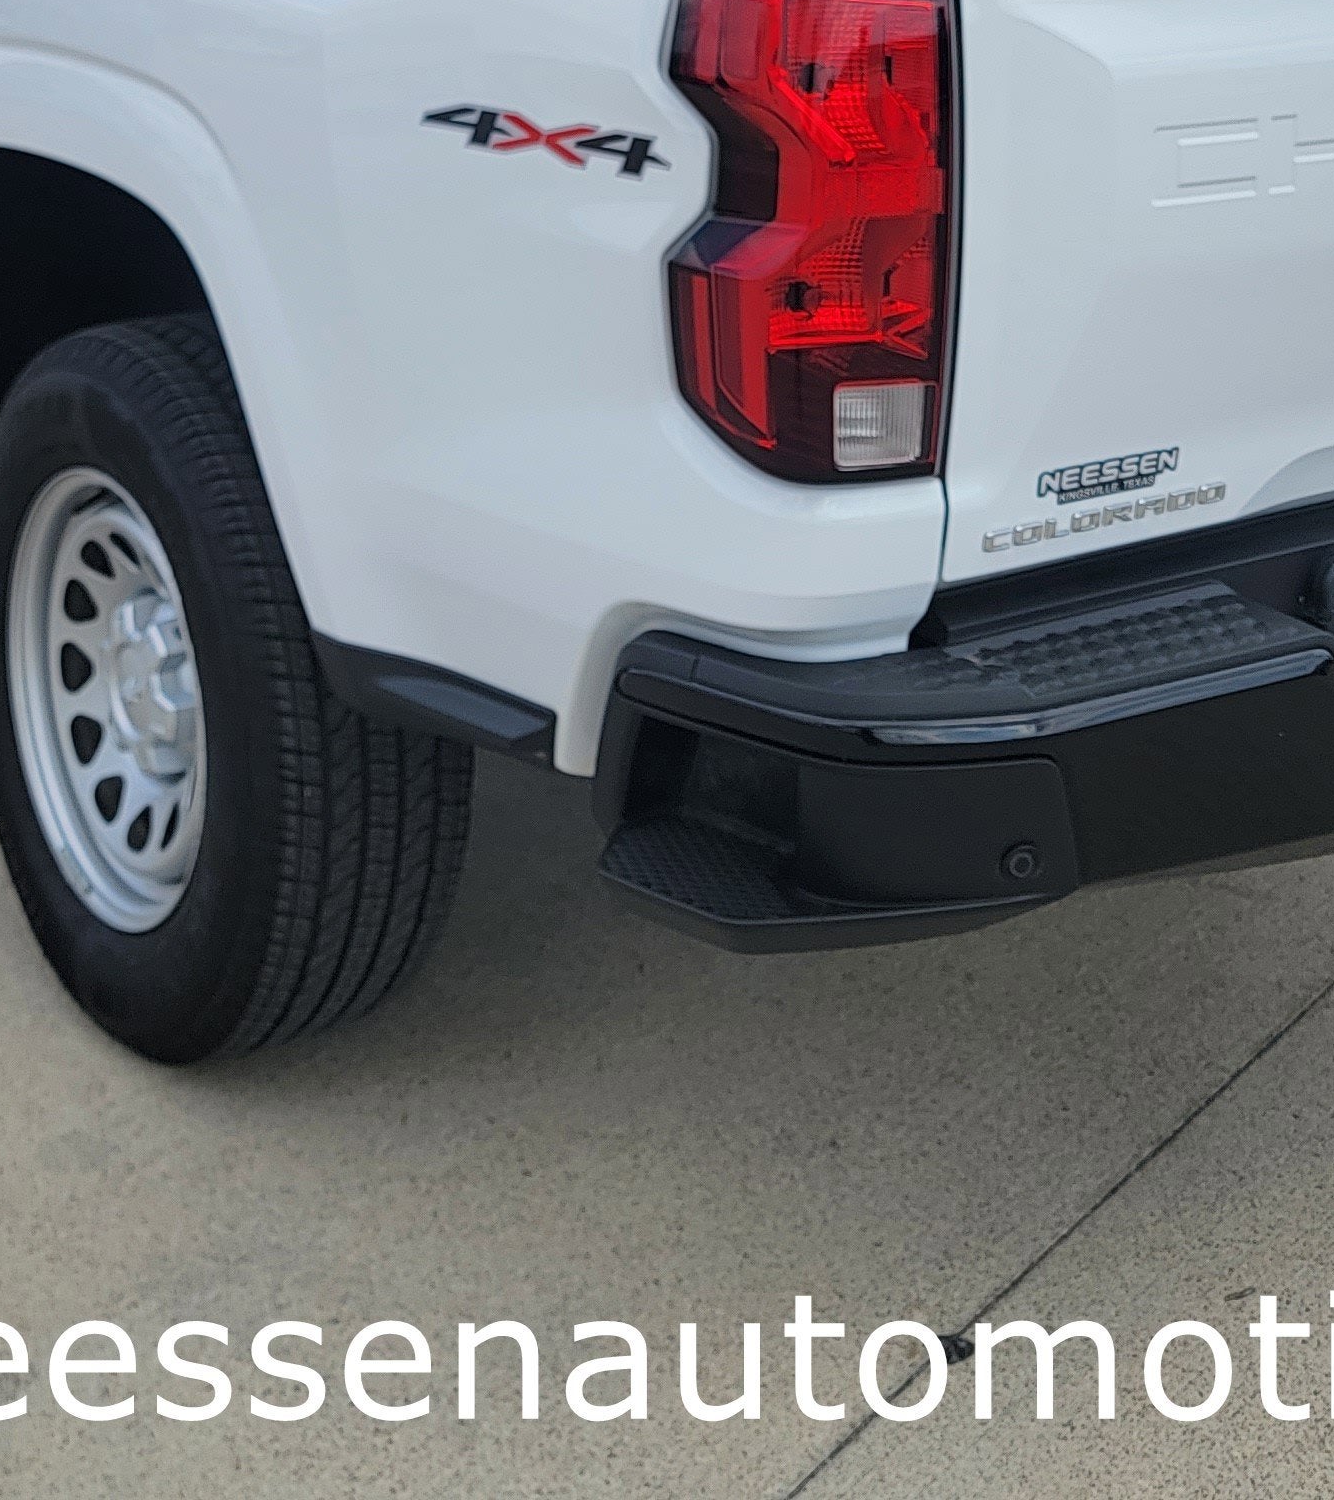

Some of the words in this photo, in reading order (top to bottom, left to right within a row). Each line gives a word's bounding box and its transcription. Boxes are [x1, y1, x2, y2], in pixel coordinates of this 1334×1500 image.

[1037, 446, 1179, 497] NEESSEN
[1123, 475, 1155, 490] TEXAS
[981, 481, 1226, 553] COLORADO
